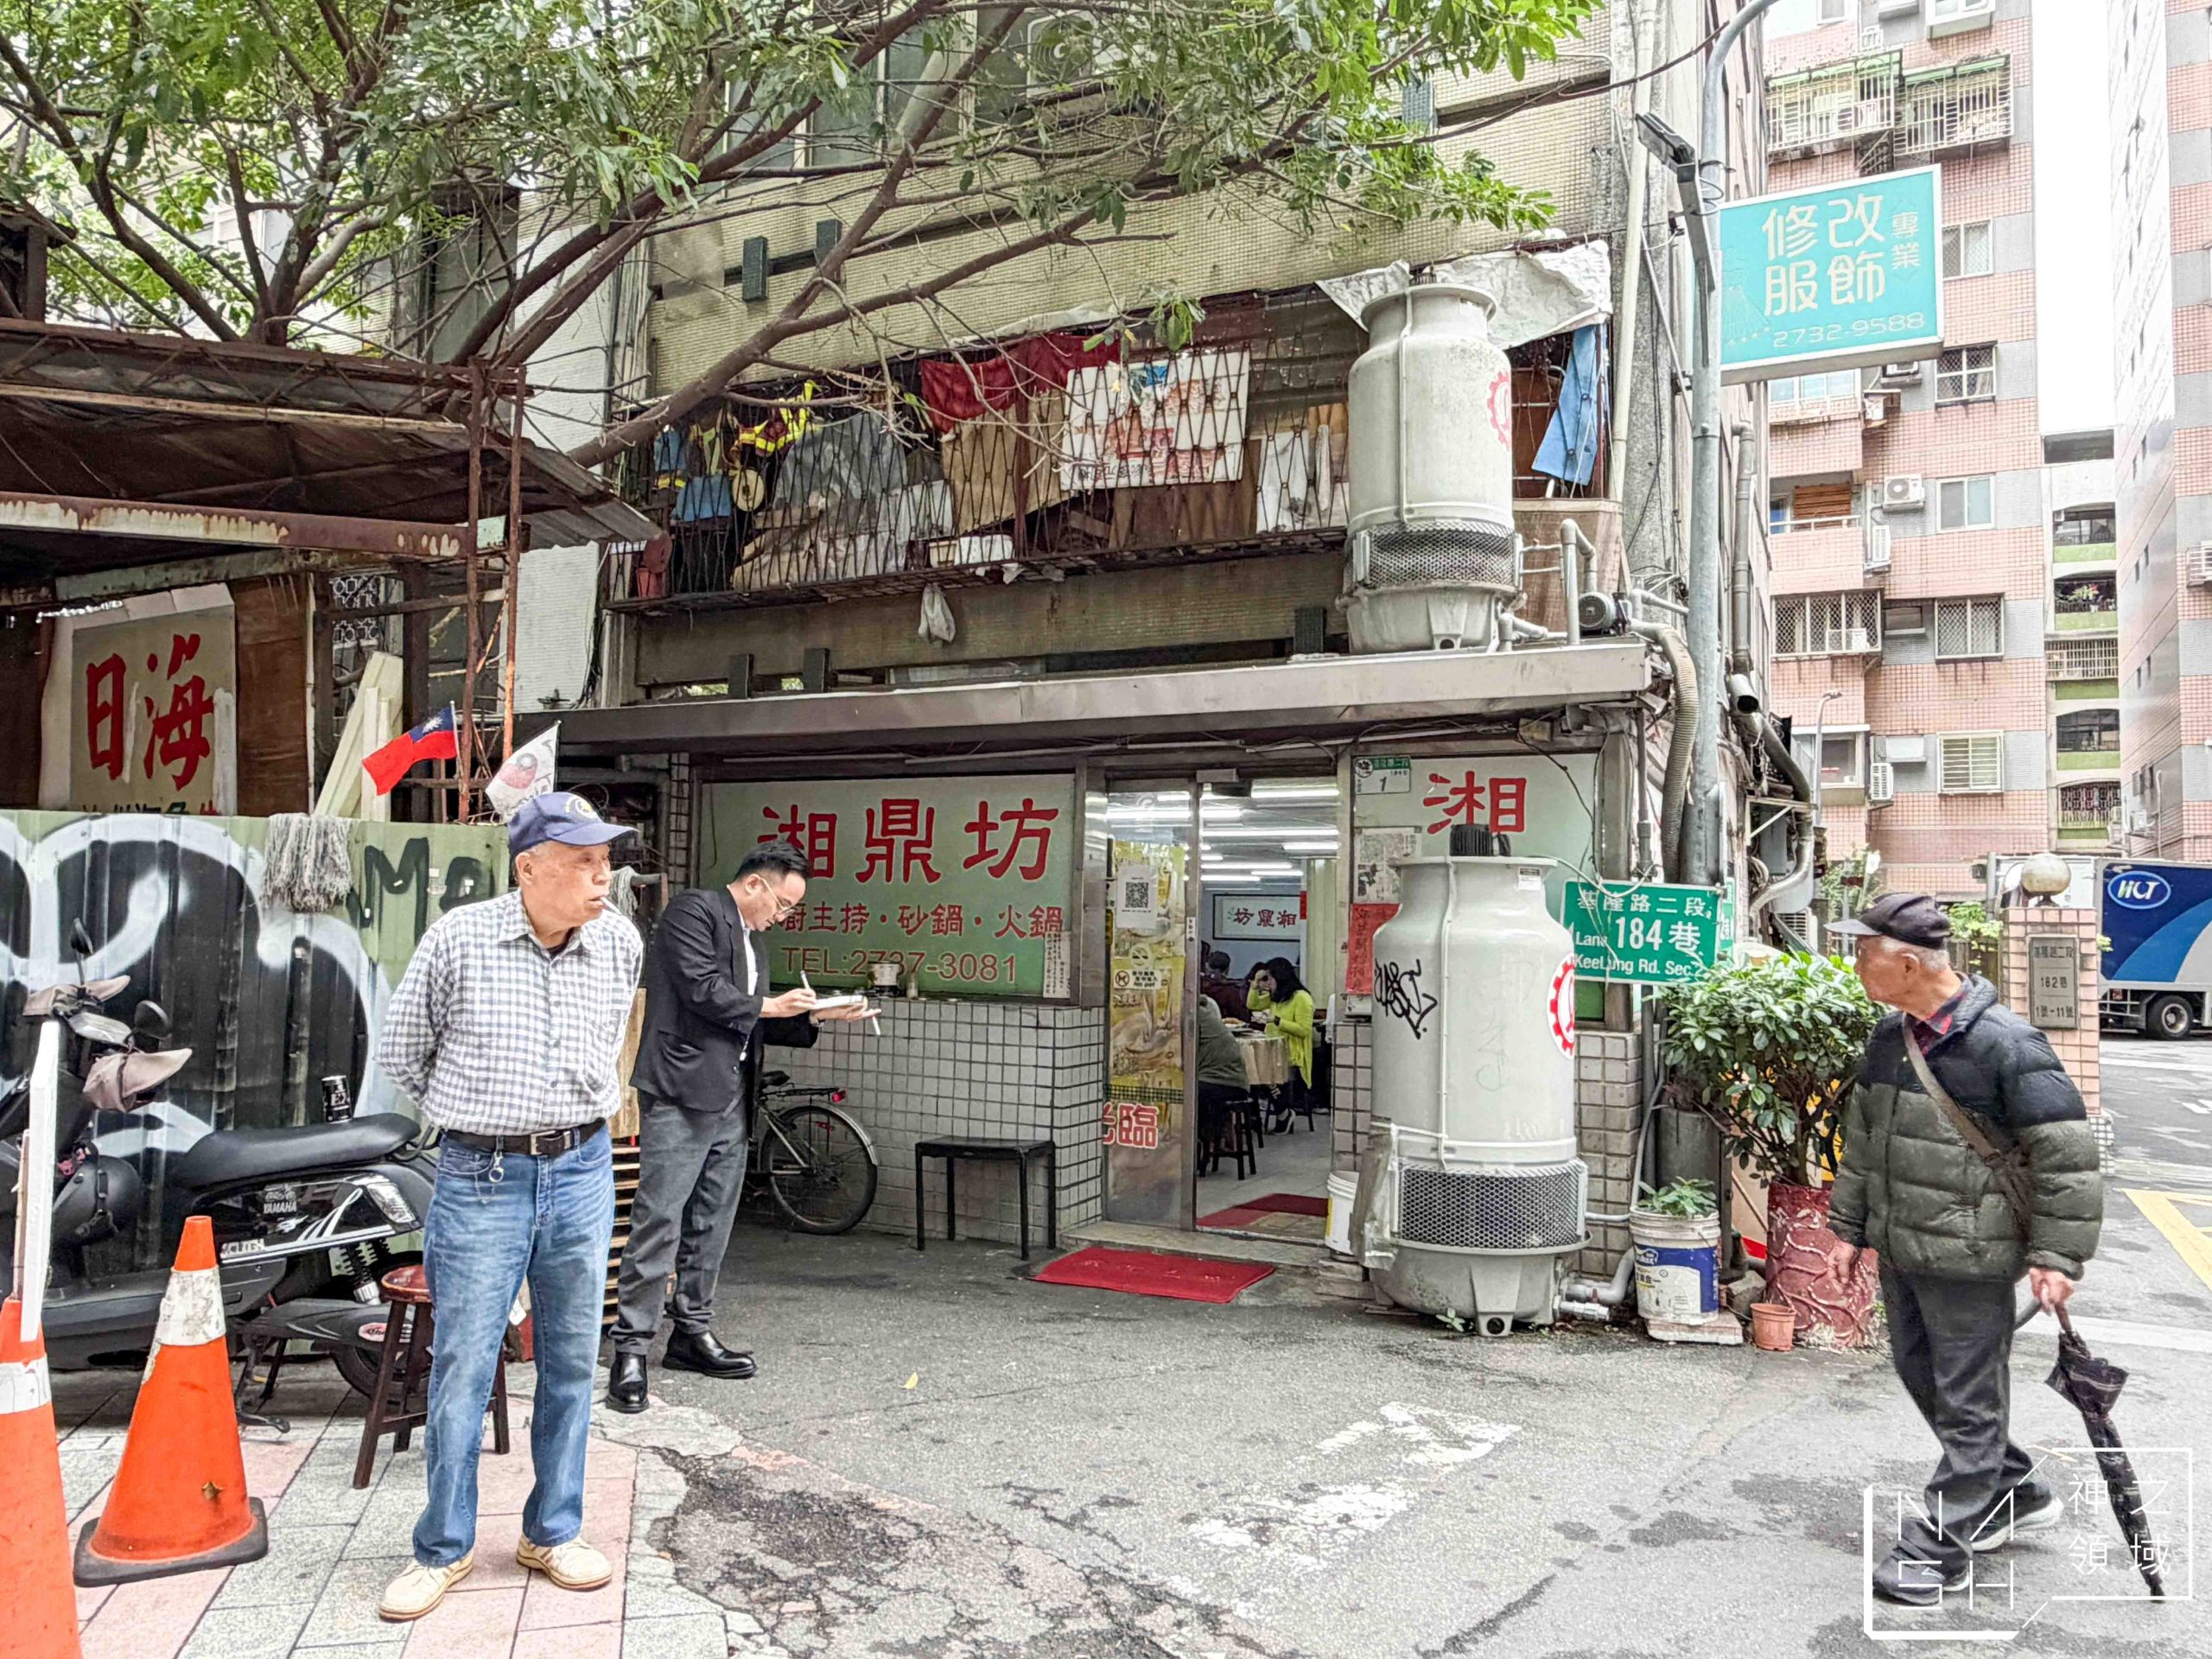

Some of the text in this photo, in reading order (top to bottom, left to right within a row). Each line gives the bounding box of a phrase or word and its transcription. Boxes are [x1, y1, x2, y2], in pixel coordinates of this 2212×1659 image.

[1762, 194, 1885, 261] 修改
[1891, 211, 1922, 270] 專業
[1764, 250, 1886, 317] 服飾
[1773, 311, 1925, 347] 2732-9588
[1379, 776, 1388, 792] 1
[1422, 770, 1527, 835] 湘
[757, 797, 1059, 885] 湘鼎坊
[1577, 888, 1708, 918] 基隆路二段
[1575, 931, 1608, 949] Lane
[1638, 958, 1661, 975] Rd.
[263, 1200, 297, 1214] YAMAHA
